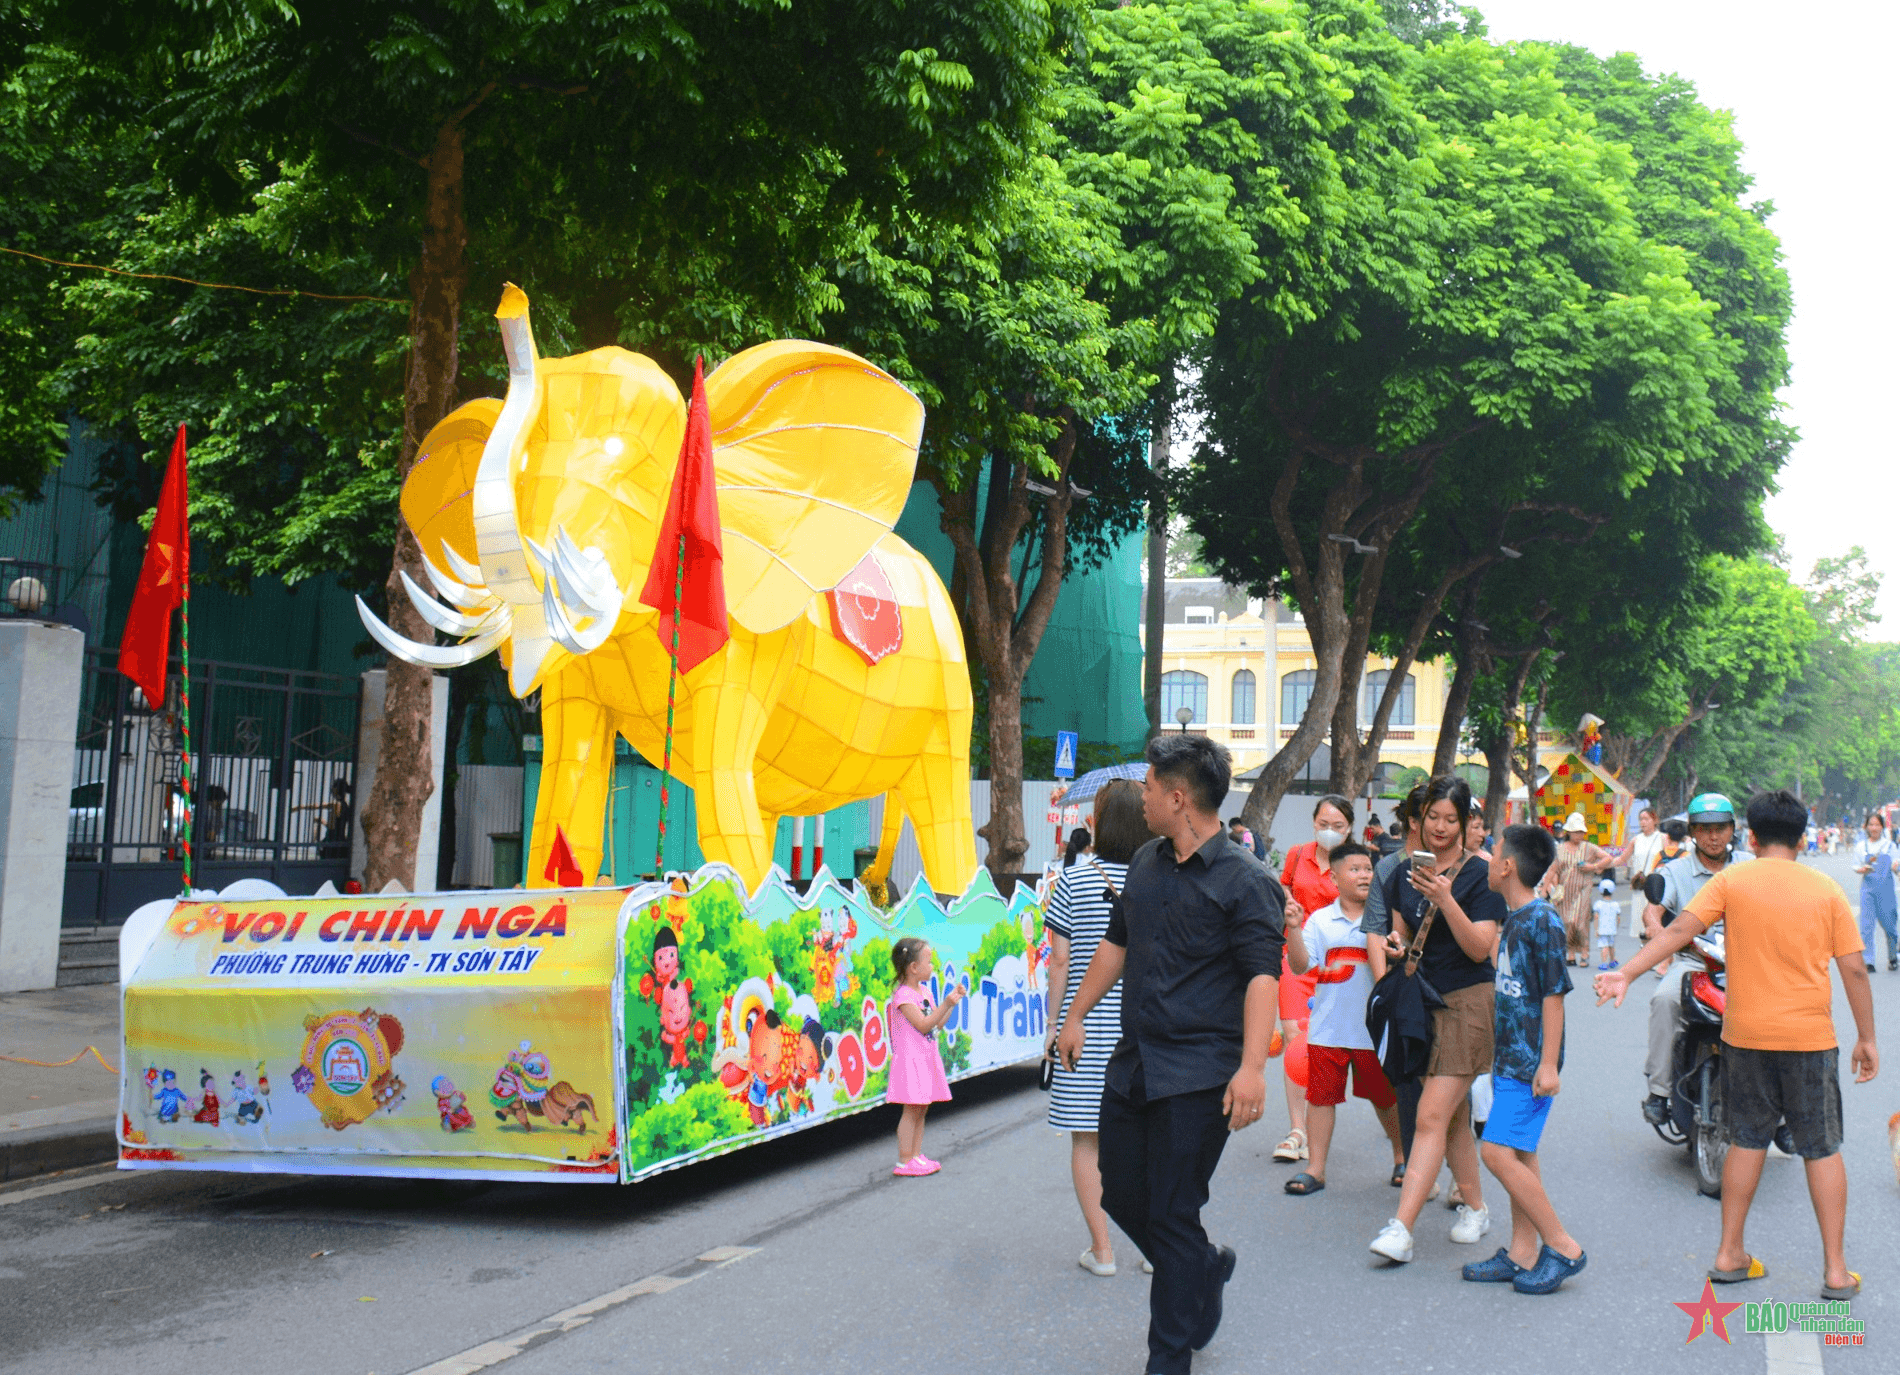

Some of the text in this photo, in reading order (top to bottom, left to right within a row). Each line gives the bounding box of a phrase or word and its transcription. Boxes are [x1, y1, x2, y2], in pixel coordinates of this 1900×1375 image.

[222, 897, 568, 943] VOI CHÍN NGÀ
[210, 951, 288, 975] PHƯỜNG
[289, 954, 354, 974] TRUNG
[353, 951, 411, 974] HƯNG
[425, 952, 452, 973] TX
[452, 948, 497, 973] SƠN
[498, 946, 539, 972] TÂY
[837, 999, 893, 1097] Đê
[981, 978, 1049, 1038] Trăn
